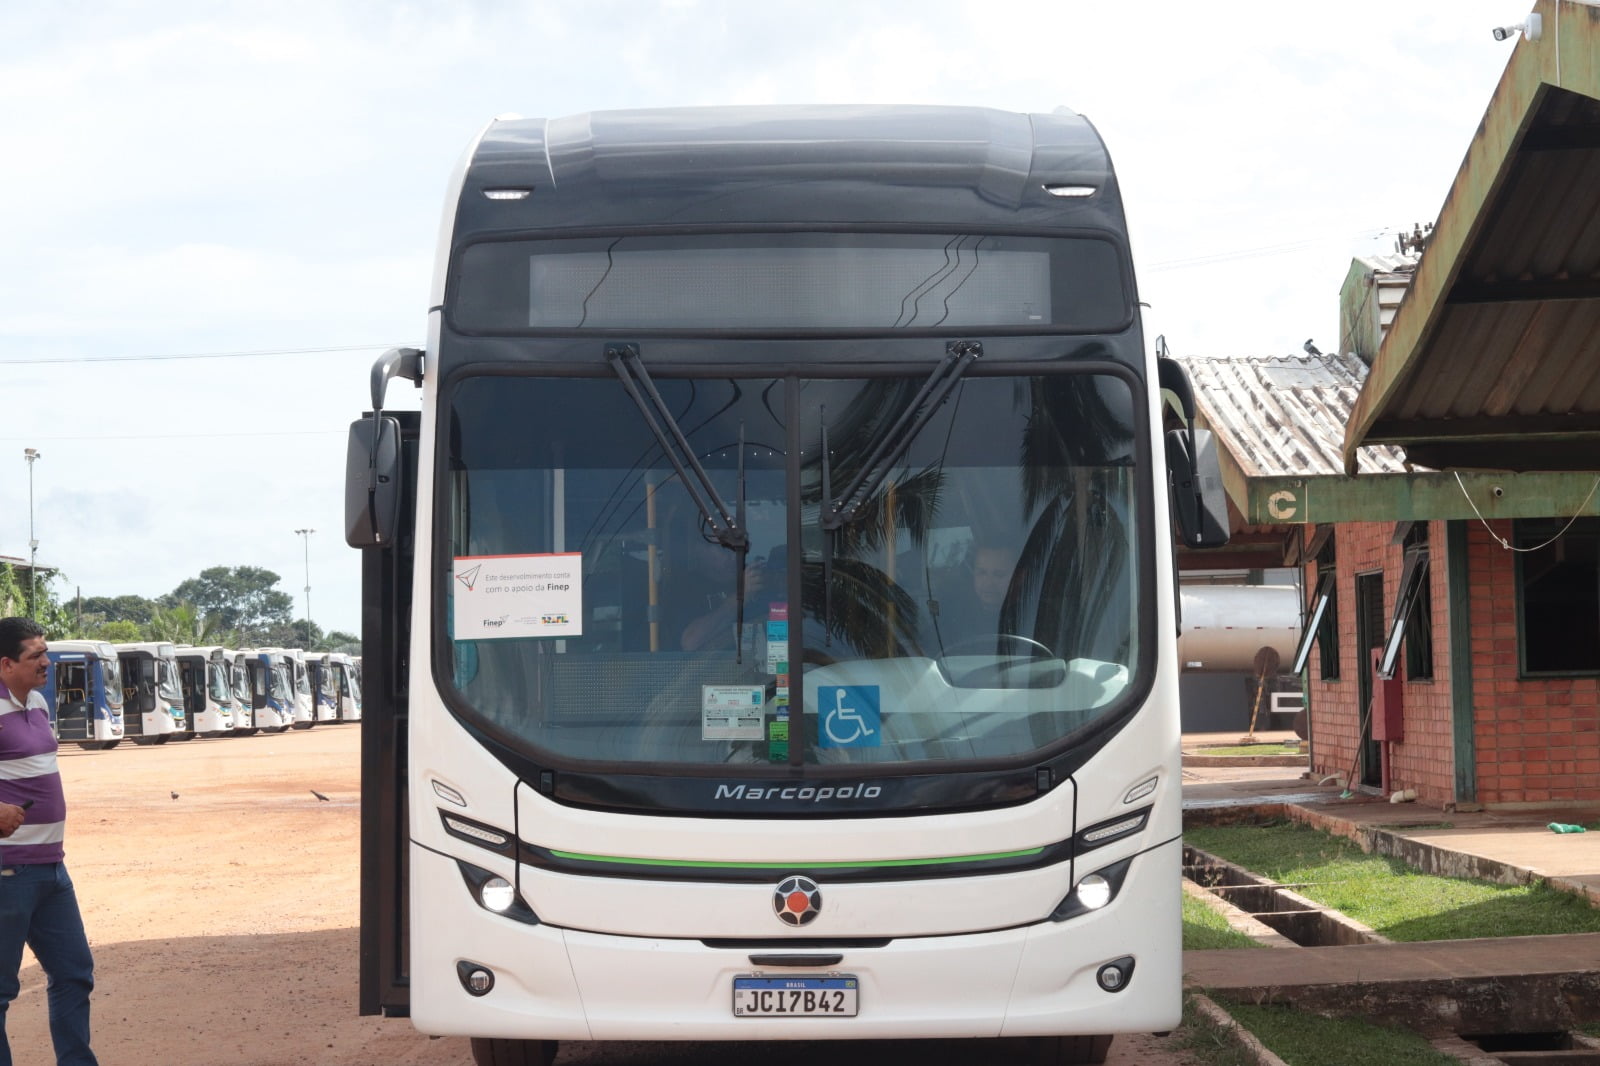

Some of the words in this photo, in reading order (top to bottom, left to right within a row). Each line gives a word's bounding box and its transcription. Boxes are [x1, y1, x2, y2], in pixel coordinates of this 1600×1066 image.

[1268, 490, 1296, 520] C
[512, 584, 534, 594] apoio
[535, 584, 544, 592] da
[547, 583, 570, 592] Finep
[483, 619, 503, 627] Finep
[714, 783, 882, 802] Marcopolo
[746, 990, 845, 1012] JCI7B42
